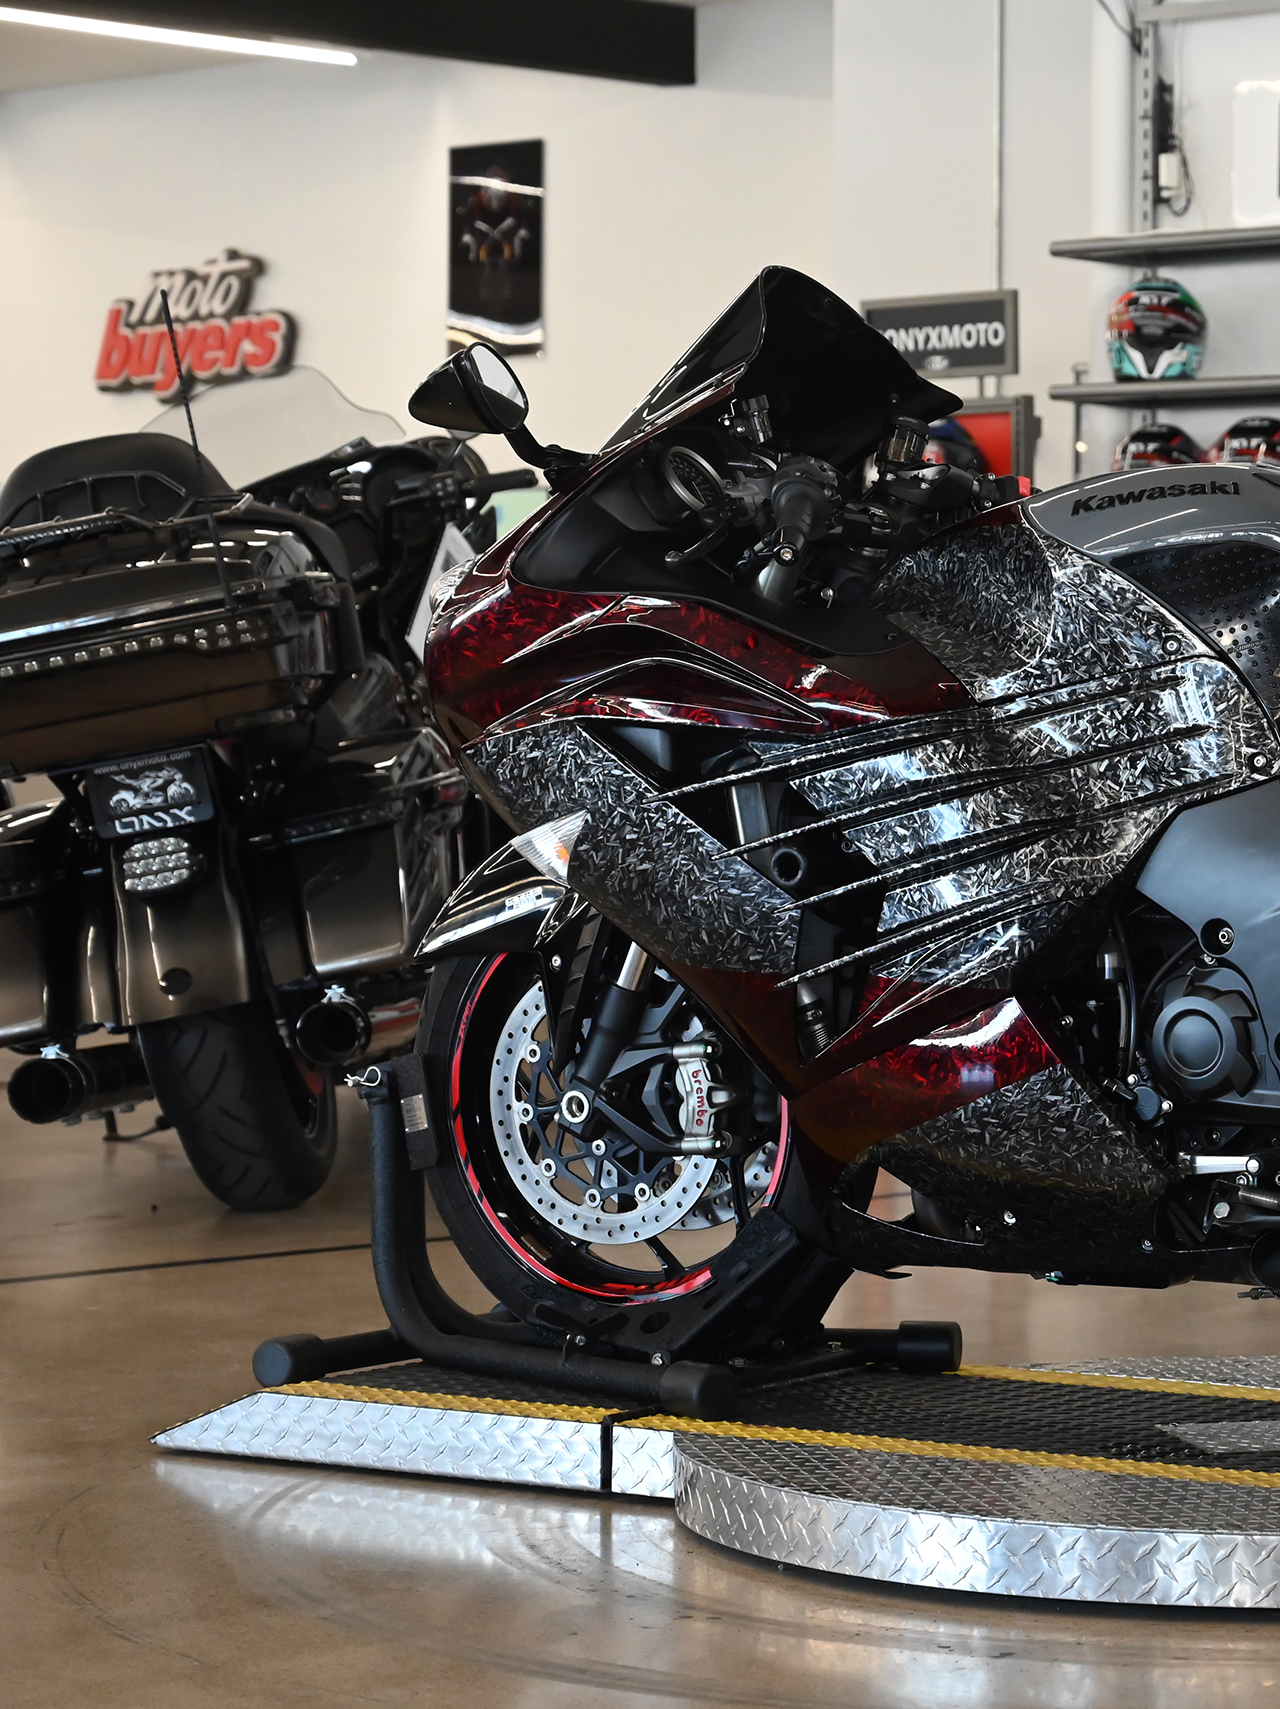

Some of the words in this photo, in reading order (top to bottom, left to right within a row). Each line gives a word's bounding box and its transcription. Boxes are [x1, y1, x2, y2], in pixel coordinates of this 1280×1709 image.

[128, 253, 251, 324] moto
[94, 307, 281, 392] buyers
[1070, 480, 1242, 517] Kawasaki
[93, 750, 192, 775] www.onyxmoto.com
[114, 805, 196, 834] ONYX
[691, 1068, 709, 1127] brembo
